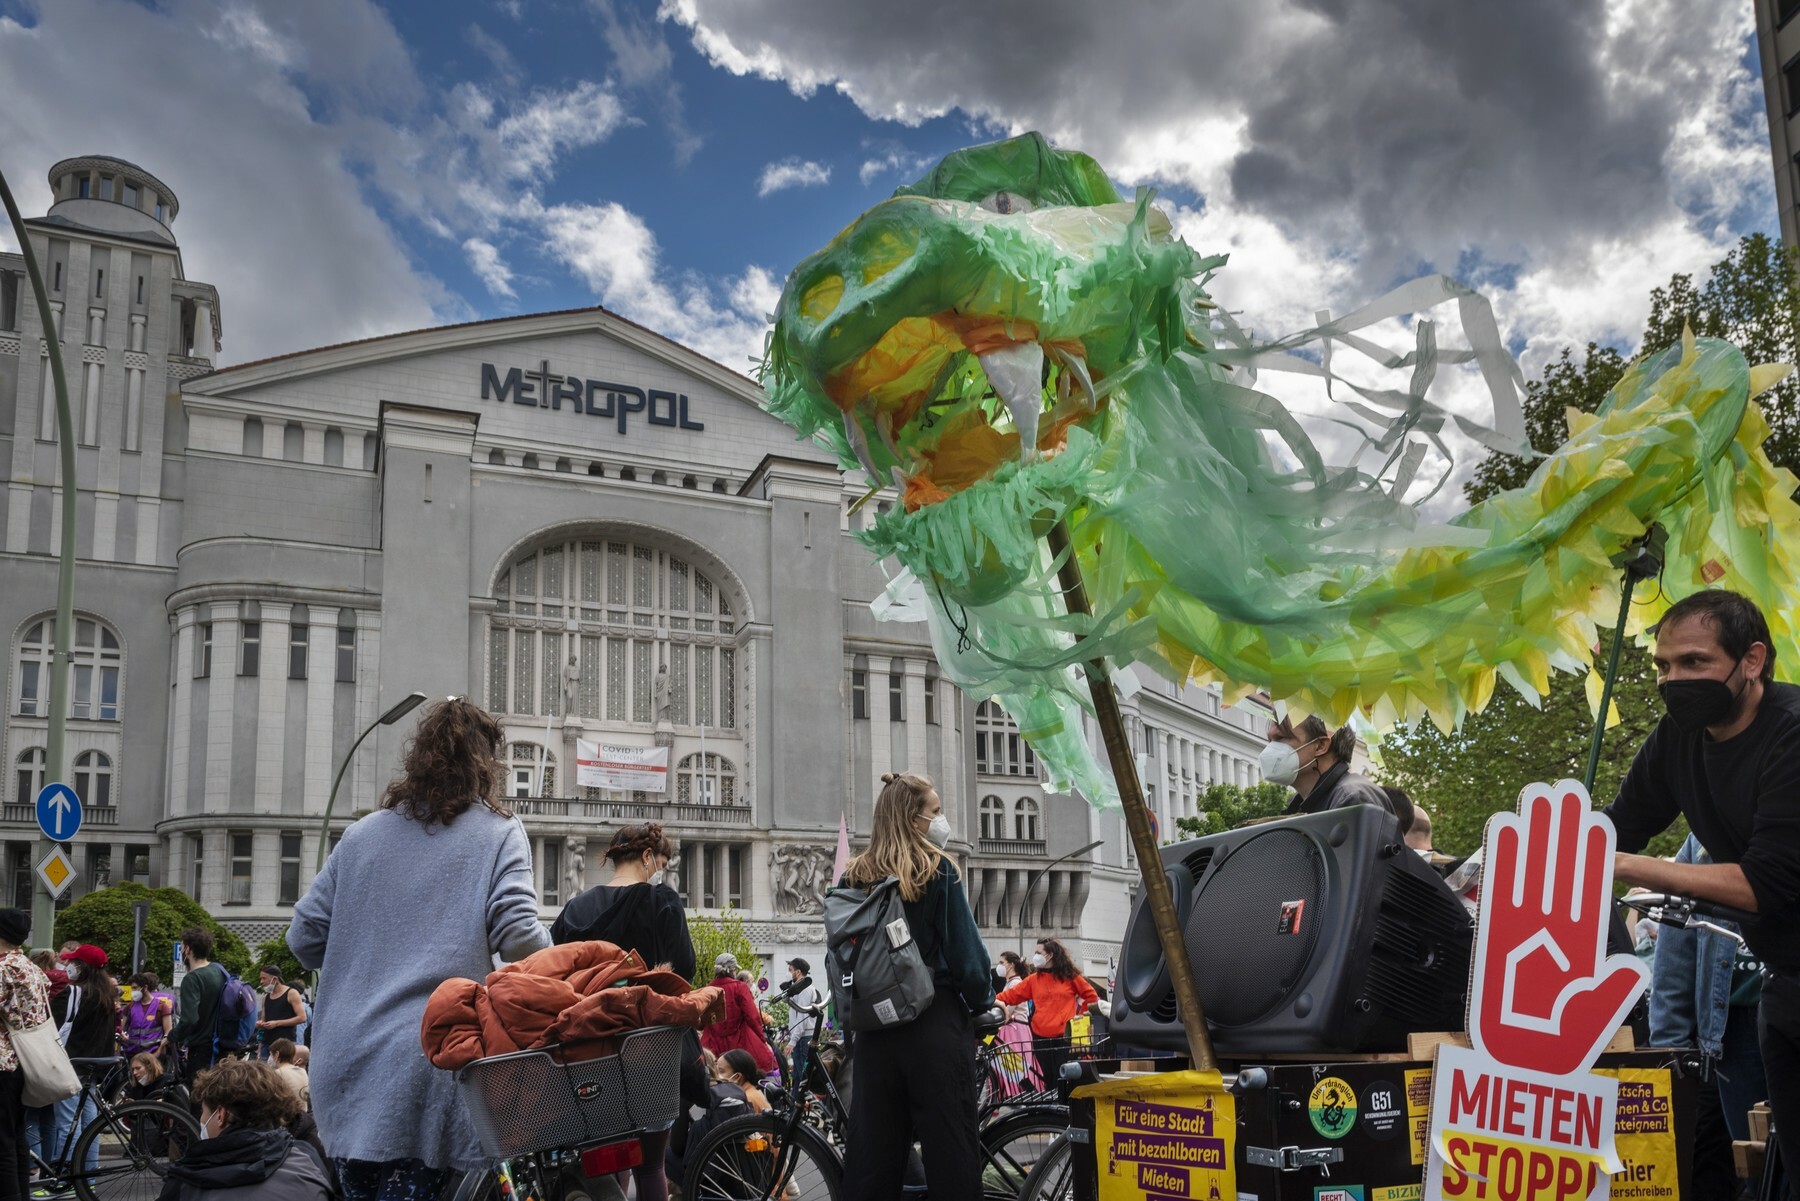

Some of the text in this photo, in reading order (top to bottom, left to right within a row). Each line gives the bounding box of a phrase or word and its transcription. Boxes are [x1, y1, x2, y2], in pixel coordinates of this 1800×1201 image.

[481, 360, 705, 434] METROPOL
[602, 745, 645, 755] COVID-19
[1371, 1091, 1392, 1111] G51
[1617, 1085, 1652, 1098] tsche
[1449, 1068, 1603, 1150] MIETEN
[1641, 1100, 1650, 1112] &
[1652, 1099, 1668, 1112] Co
[1119, 1105, 1206, 1134] Für eine Stadt
[1615, 1117, 1667, 1133] nteignen!
[1117, 1139, 1220, 1164] mit bezahlbaren
[1142, 1167, 1185, 1192] Mieten
[1610, 1185, 1673, 1198] terschreiben
